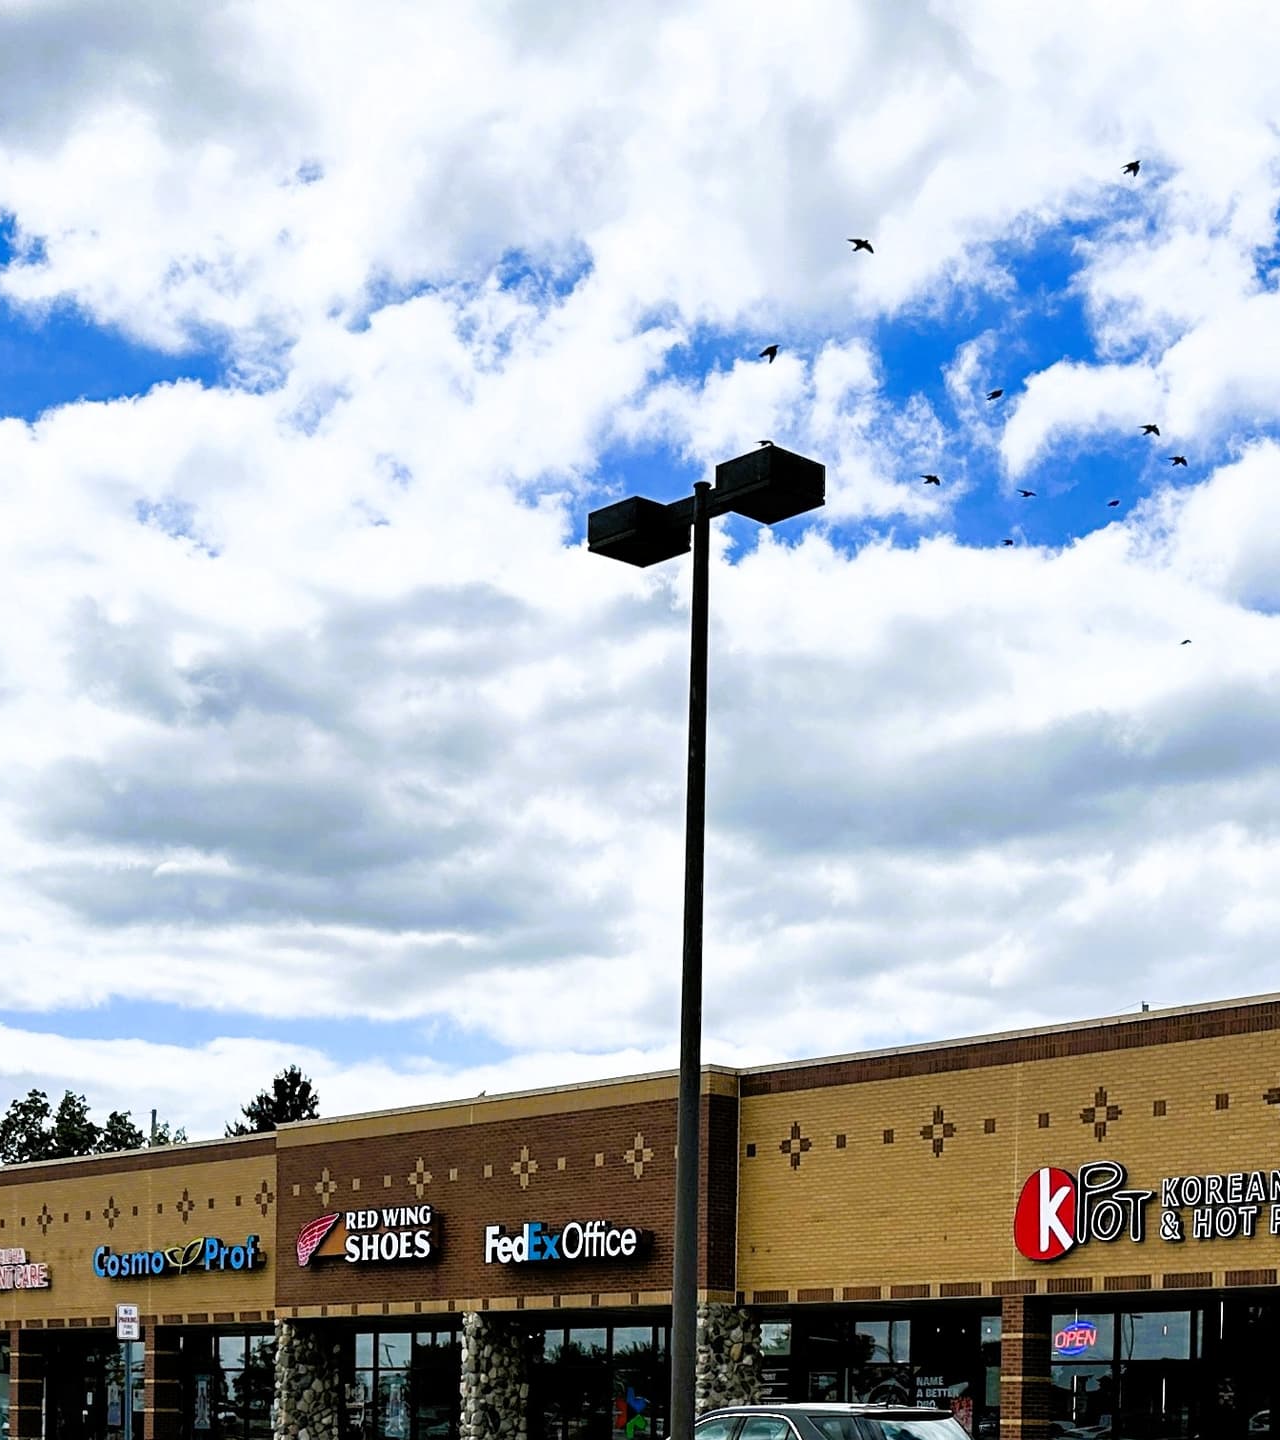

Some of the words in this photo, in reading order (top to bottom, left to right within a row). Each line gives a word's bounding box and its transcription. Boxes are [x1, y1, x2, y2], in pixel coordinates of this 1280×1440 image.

[345, 1210, 378, 1230] RED
[382, 1205, 431, 1228] WING
[1160, 1210, 1182, 1240] &
[1192, 1206, 1258, 1238] HOT
[345, 1230, 431, 1263] SHOES
[485, 1221, 560, 1263] FedEx
[561, 1220, 637, 1259] Office
[93, 1246, 165, 1278] Cosmo
[204, 1235, 260, 1272] Prof
[14, 1263, 48, 1288] CARE
[1055, 1329, 1097, 1348] OPEN
[916, 1376, 944, 1386] NAME
[916, 1388, 923, 1398] A
[925, 1388, 960, 1398] BETTER
